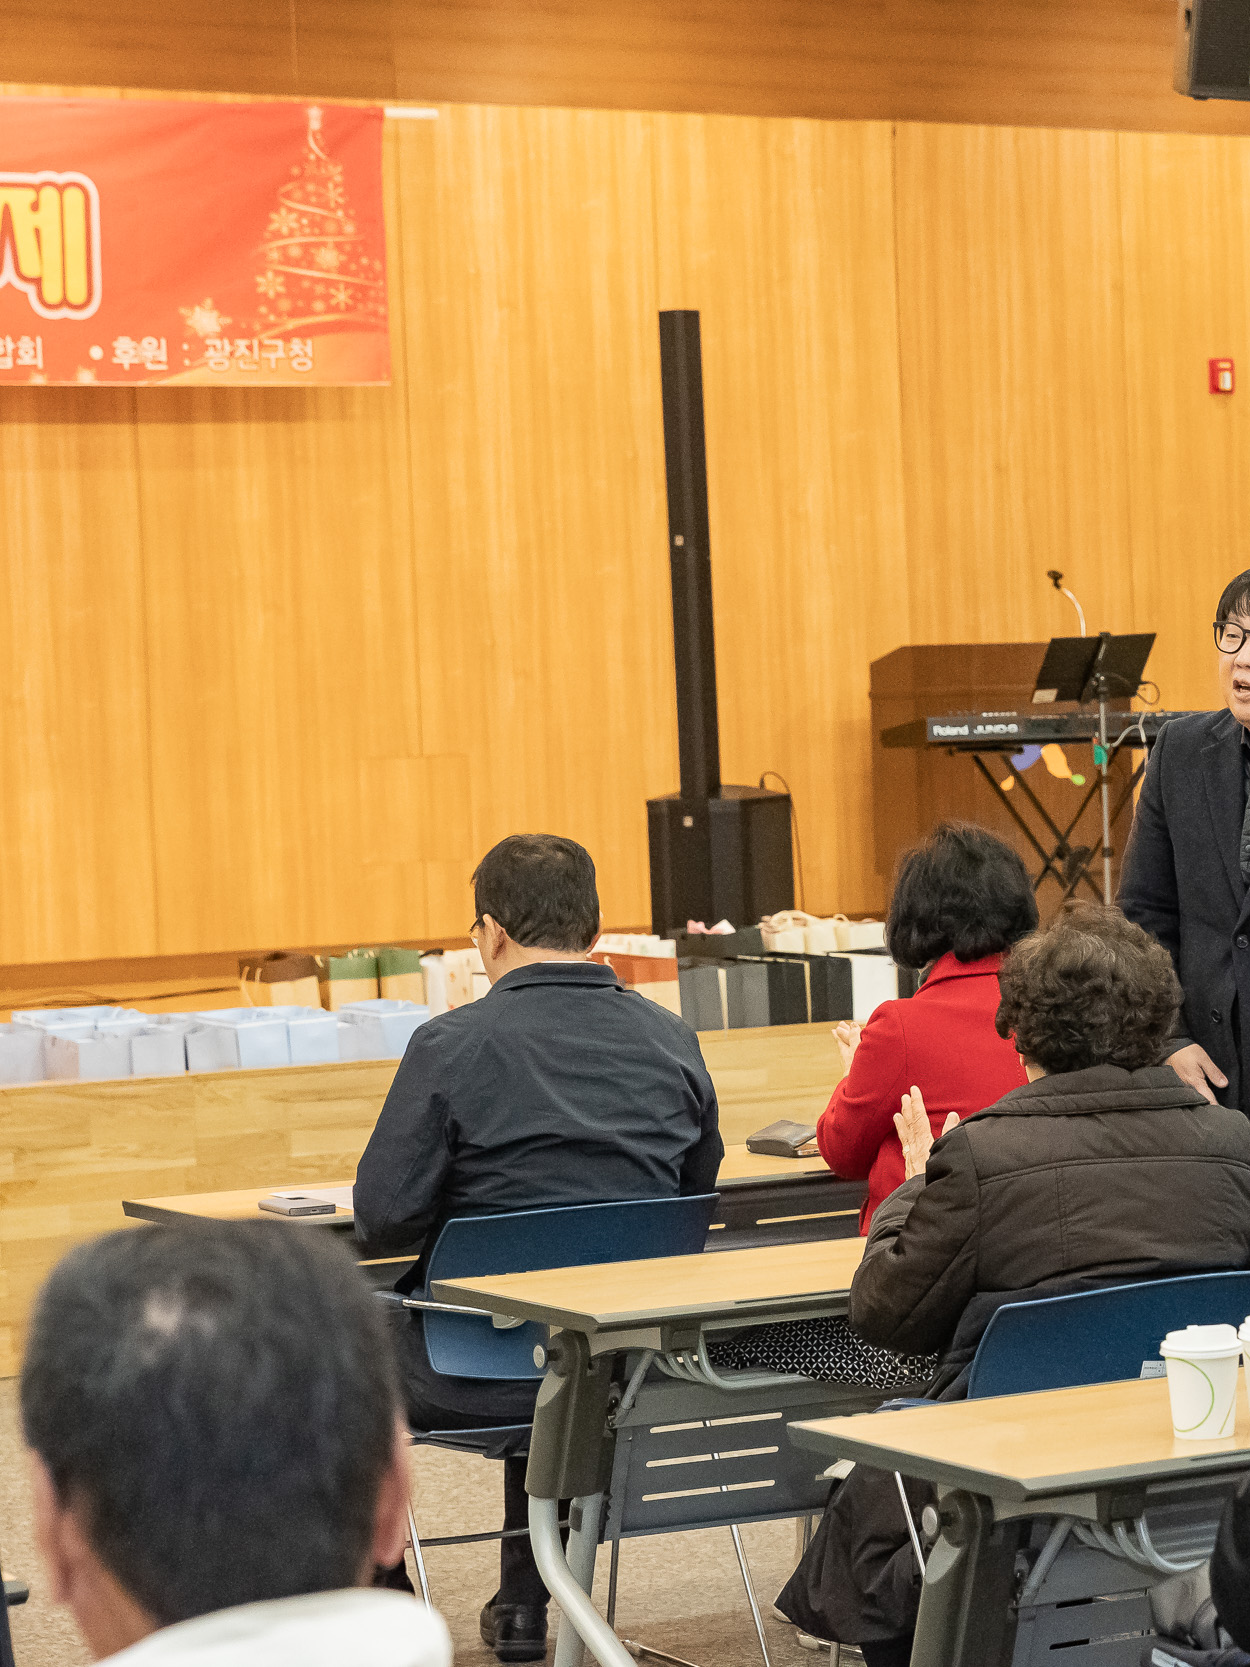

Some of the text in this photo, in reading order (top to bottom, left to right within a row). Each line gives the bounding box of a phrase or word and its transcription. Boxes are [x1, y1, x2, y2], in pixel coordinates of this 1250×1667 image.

[112, 335, 169, 371] 후원
[204, 337, 314, 372] 광진구청
[932, 724, 969, 737] Roland
